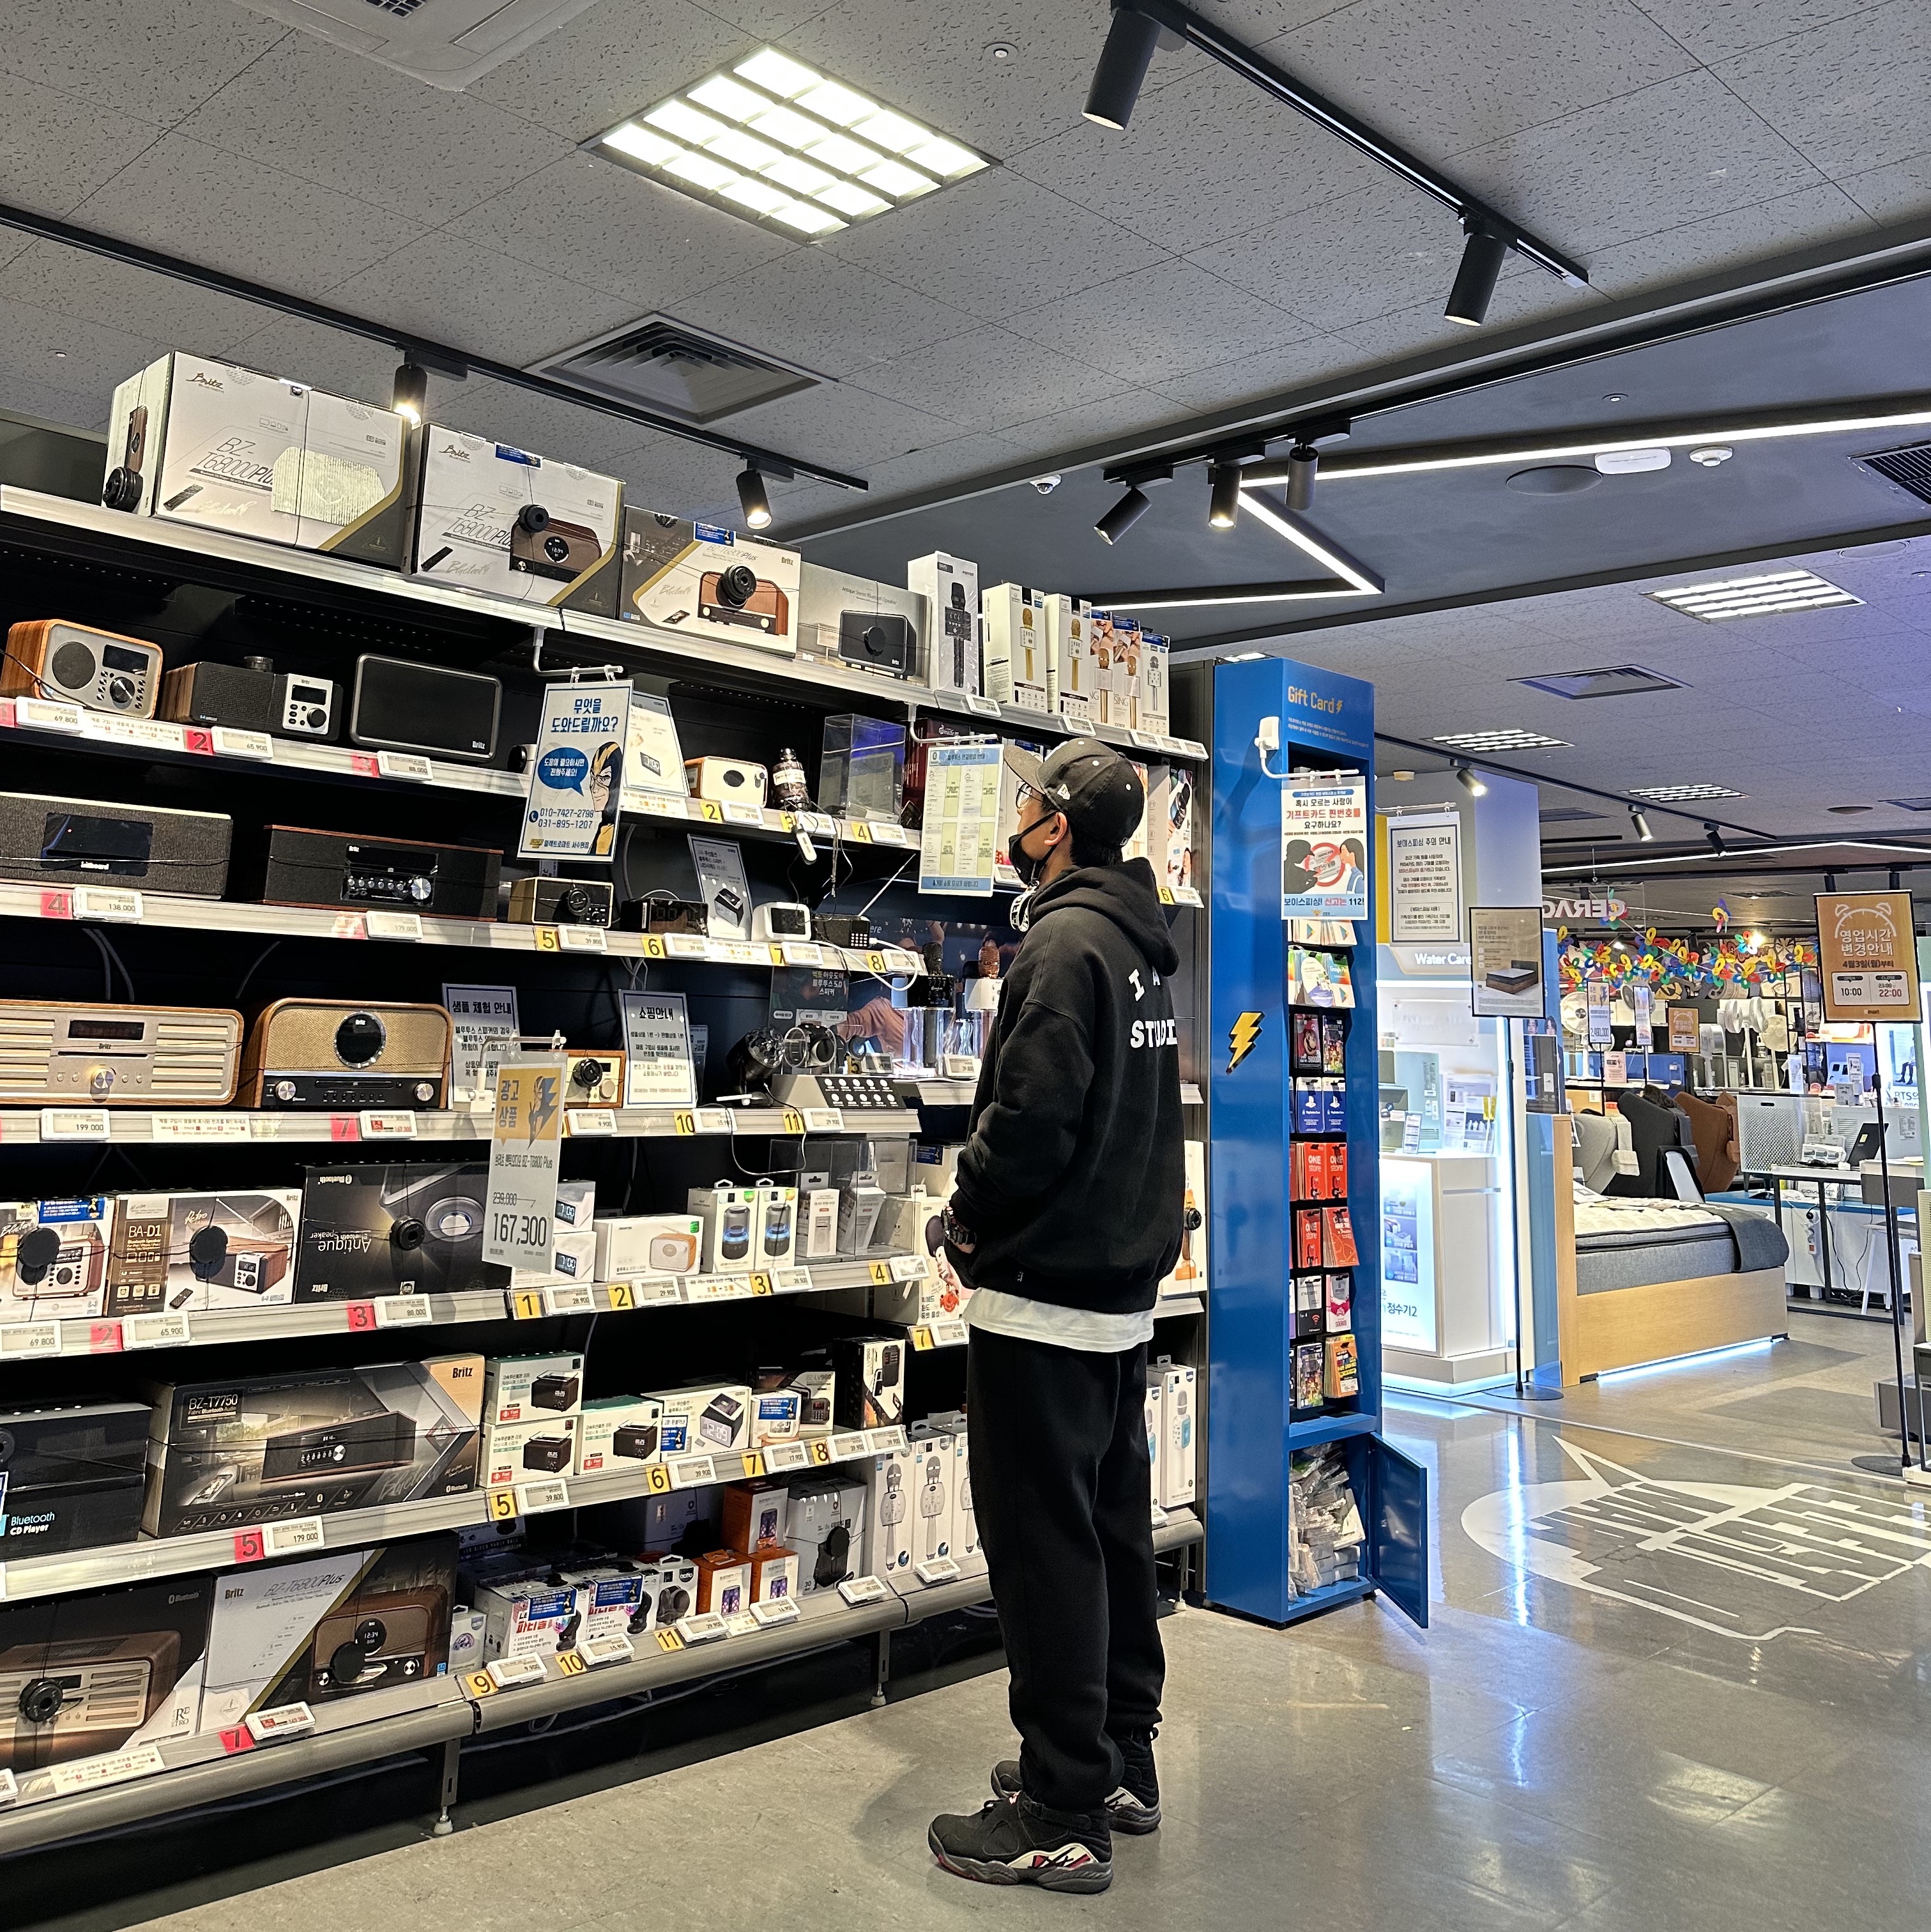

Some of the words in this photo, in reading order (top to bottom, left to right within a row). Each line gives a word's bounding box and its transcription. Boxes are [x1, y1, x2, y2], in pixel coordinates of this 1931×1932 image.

[217, 438, 256, 457] BZ-
[196, 452, 273, 486] T68000Plu
[574, 698, 602, 714] 무엇을
[1287, 686, 1308, 705] Gift
[1310, 692, 1335, 714] Card
[551, 716, 619, 733] 도와드릴까요?
[192, 732, 208, 751] 2
[1310, 798, 1331, 807] 모르는
[1332, 797, 1353, 806] 사람이
[706, 804, 719, 821] 2
[1286, 809, 1327, 820] 기프트카드
[858, 825, 867, 841] 4
[1304, 820, 1342, 829] 요구하나요?
[1396, 838, 1424, 848] 보이스피싱
[1425, 837, 1437, 847] 주의
[1439, 836, 1452, 846] 안내
[48, 894, 66, 914] 4
[1161, 889, 1170, 902] 6
[1283, 897, 1323, 907] 보이스피싱!
[1348, 897, 1365, 906] 112!
[543, 931, 555, 949] 5
[1840, 928, 1893, 943] 영업시간
[648, 939, 660, 956] 6
[1840, 942, 1895, 957] 변경안내
[871, 955, 882, 970] 8
[1414, 952, 1446, 965] Water
[1447, 953, 1472, 965] Care
[1842, 959, 1895, 969] 4월3일(월)부터
[819, 988, 836, 997] 스피커
[1128, 969, 1145, 1002] I
[1840, 987, 1863, 997] 10:00
[1879, 988, 1902, 998] 22:00
[452, 1000, 470, 1014] 샘플
[472, 1001, 491, 1015] 체험
[494, 1002, 512, 1015] 안내
[639, 1007, 675, 1021] 쇼핑안내
[851, 1059, 860, 1074] 5
[499, 1106, 518, 1129] 상품
[676, 1114, 695, 1133] 10
[784, 1113, 801, 1131] 11
[336, 1117, 350, 1137] 7
[1308, 1155, 1322, 1165] ONE
[128, 1224, 162, 1238] BA-D1
[494, 1211, 547, 1248] 167,300
[317, 1239, 372, 1255] Antique
[876, 1264, 885, 1283] 4
[754, 1275, 766, 1295] 3
[521, 1295, 533, 1316] 1
[615, 1286, 629, 1308] 2
[352, 1305, 368, 1328] 3
[1387, 1301, 1418, 1318] 정수기2
[100, 1324, 114, 1345] 2
[915, 1329, 926, 1348] 7
[452, 1366, 473, 1379] Britz
[188, 1393, 238, 1411] BZ-T7750
[706, 1422, 728, 1442] 12:09
[816, 1443, 828, 1462] 8
[745, 1453, 758, 1476] 7
[651, 1468, 665, 1489] 6
[496, 1493, 511, 1517] 5
[10, 1511, 56, 1526] Bluetooth
[10, 1524, 24, 1536] CD
[25, 1522, 50, 1535] Player
[242, 1536, 258, 1557] 5
[225, 1586, 245, 1600] Britz
[657, 1631, 680, 1650] 11
[559, 1653, 583, 1675] 10
[473, 1675, 492, 1694] 9
[227, 1732, 241, 1749] 7
